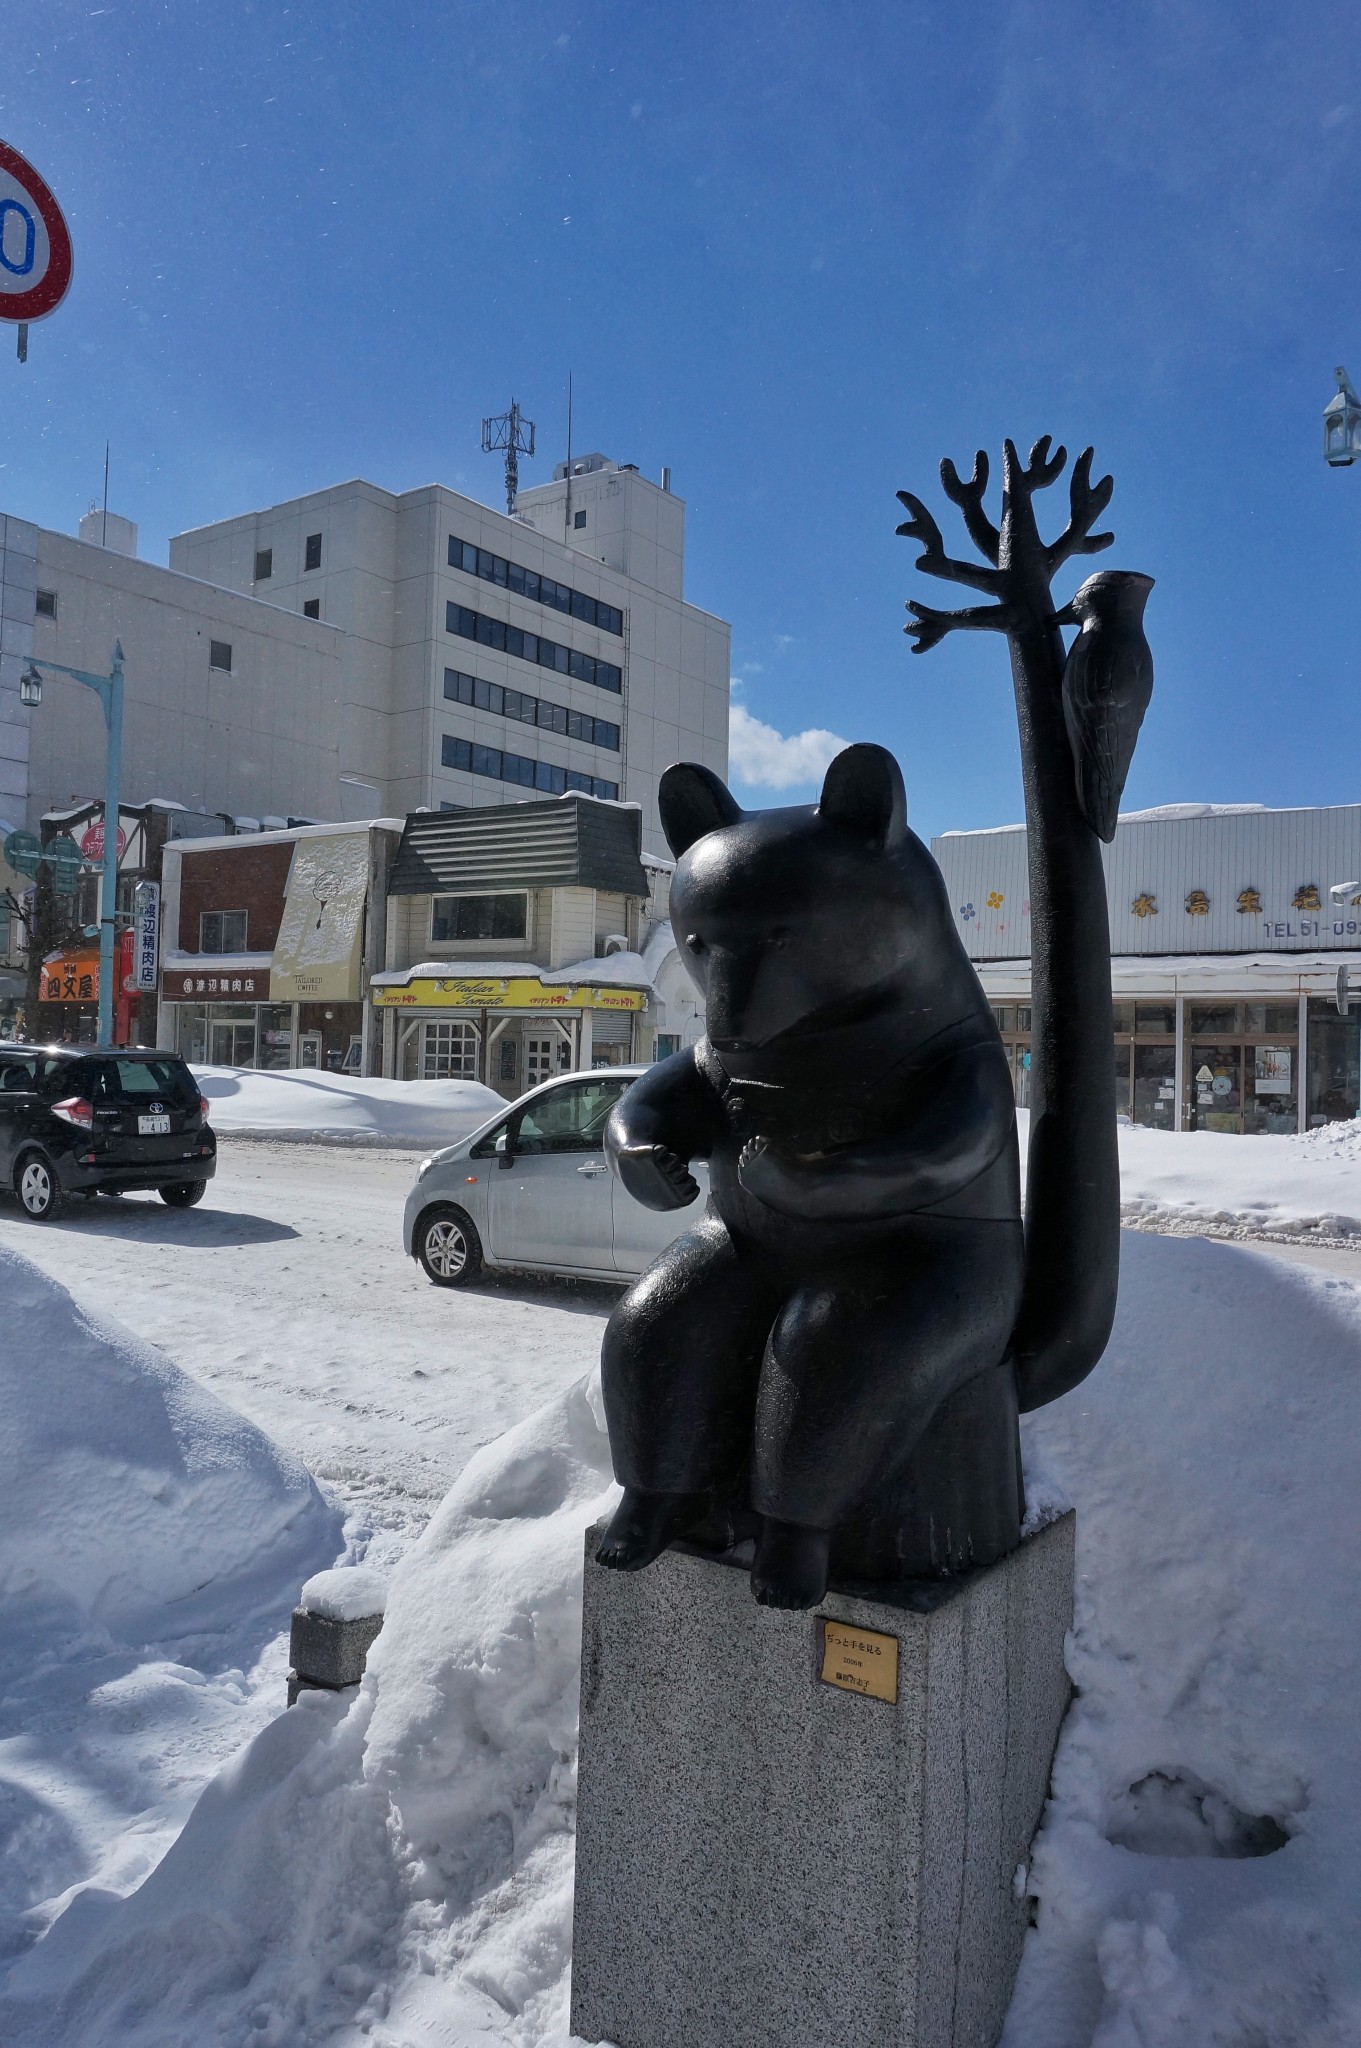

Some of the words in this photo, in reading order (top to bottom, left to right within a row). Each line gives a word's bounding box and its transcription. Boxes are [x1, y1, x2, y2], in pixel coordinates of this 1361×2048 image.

[1300, 921, 1361, 937] 51-09
[195, 978, 255, 992] 渡辺精肉店
[293, 974, 323, 984] TAILORED
[443, 981, 494, 993] Italian
[456, 992, 508, 1005] Tomato
